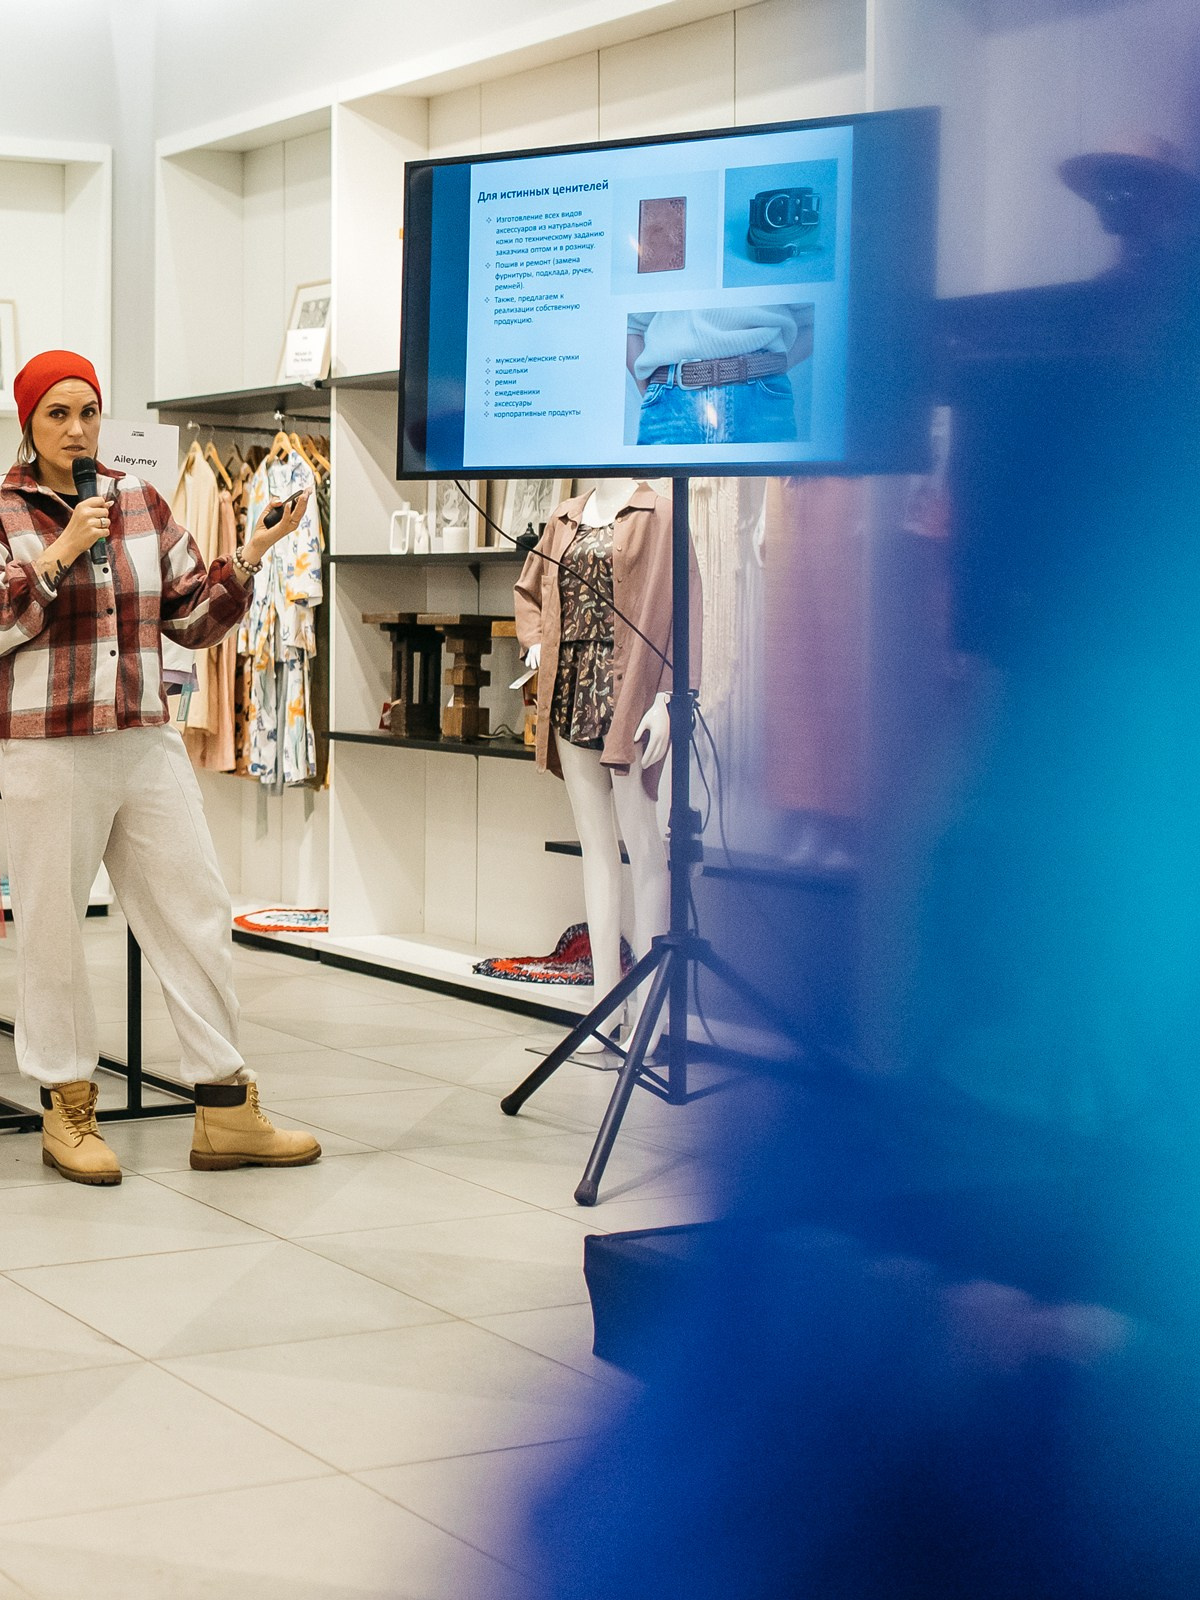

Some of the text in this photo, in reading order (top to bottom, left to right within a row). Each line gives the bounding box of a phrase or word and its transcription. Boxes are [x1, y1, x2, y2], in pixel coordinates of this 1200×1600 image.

[478, 179, 609, 203] Для истинных ценителей
[496, 214, 543, 223] Изготовление
[561, 210, 582, 218] видов
[496, 225, 537, 234] аксессуаров
[548, 219, 593, 230] натуральной
[525, 233, 572, 242] техническому
[574, 230, 604, 240] заданию
[496, 248, 528, 256] заказчика
[565, 242, 596, 252] розницу.
[495, 261, 518, 269] Пошив
[526, 259, 551, 268] ремонт
[552, 257, 580, 266] (замена
[495, 267, 594, 280] фурнитуры, подклада, ручек,
[494, 282, 524, 292] ремней).
[494, 296, 516, 304] Также,
[518, 293, 558, 303] предлагаем
[494, 303, 580, 315] реализации собственную
[494, 317, 533, 326] продукцию.
[496, 354, 580, 364] мужские/женские сумки
[495, 379, 517, 387] ремни
[494, 400, 532, 408] аксессуары
[494, 409, 581, 418] корпоративные продукты
[114, 455, 158, 467] Ailey.mey
